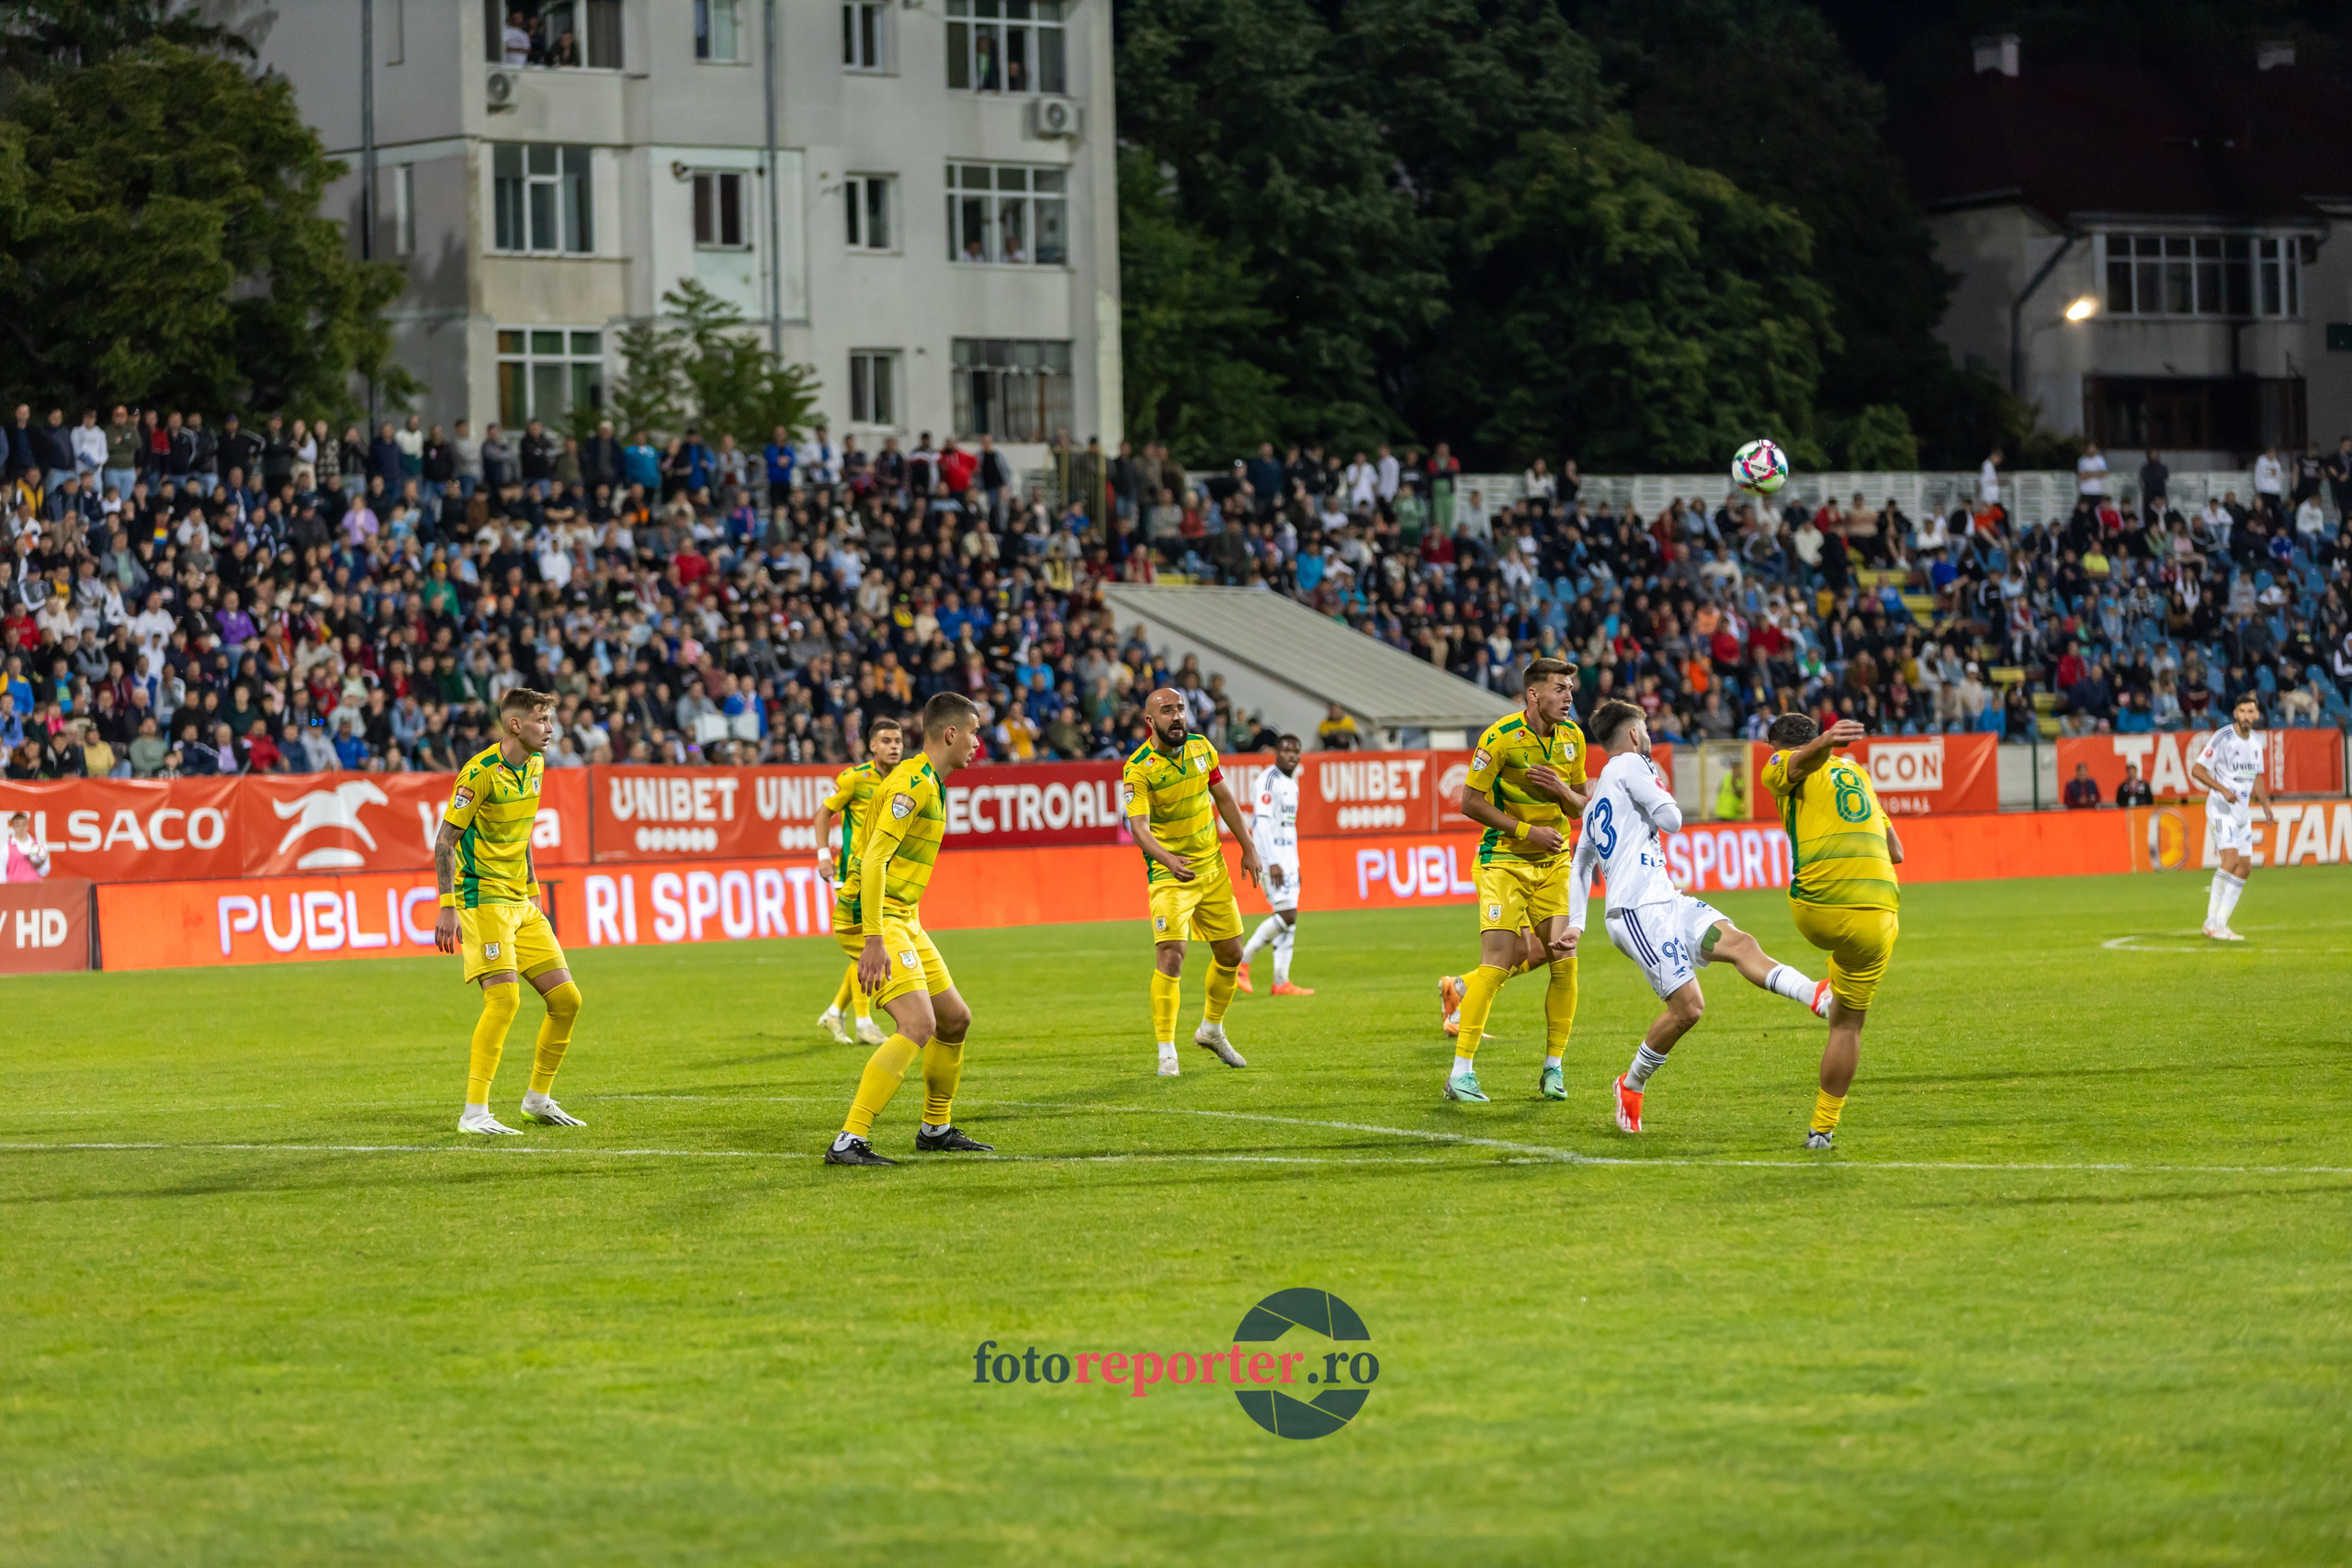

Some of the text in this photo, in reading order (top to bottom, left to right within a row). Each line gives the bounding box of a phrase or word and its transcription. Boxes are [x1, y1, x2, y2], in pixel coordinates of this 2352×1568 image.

[1319, 760, 1426, 803] UNIBET
[1874, 752, 1939, 782] CON
[609, 776, 739, 822] UNIBET
[943, 780, 1126, 834] ECTROAL
[1831, 767, 1871, 823] 8
[650, 866, 837, 942] SPORTI
[16, 908, 68, 949] HD
